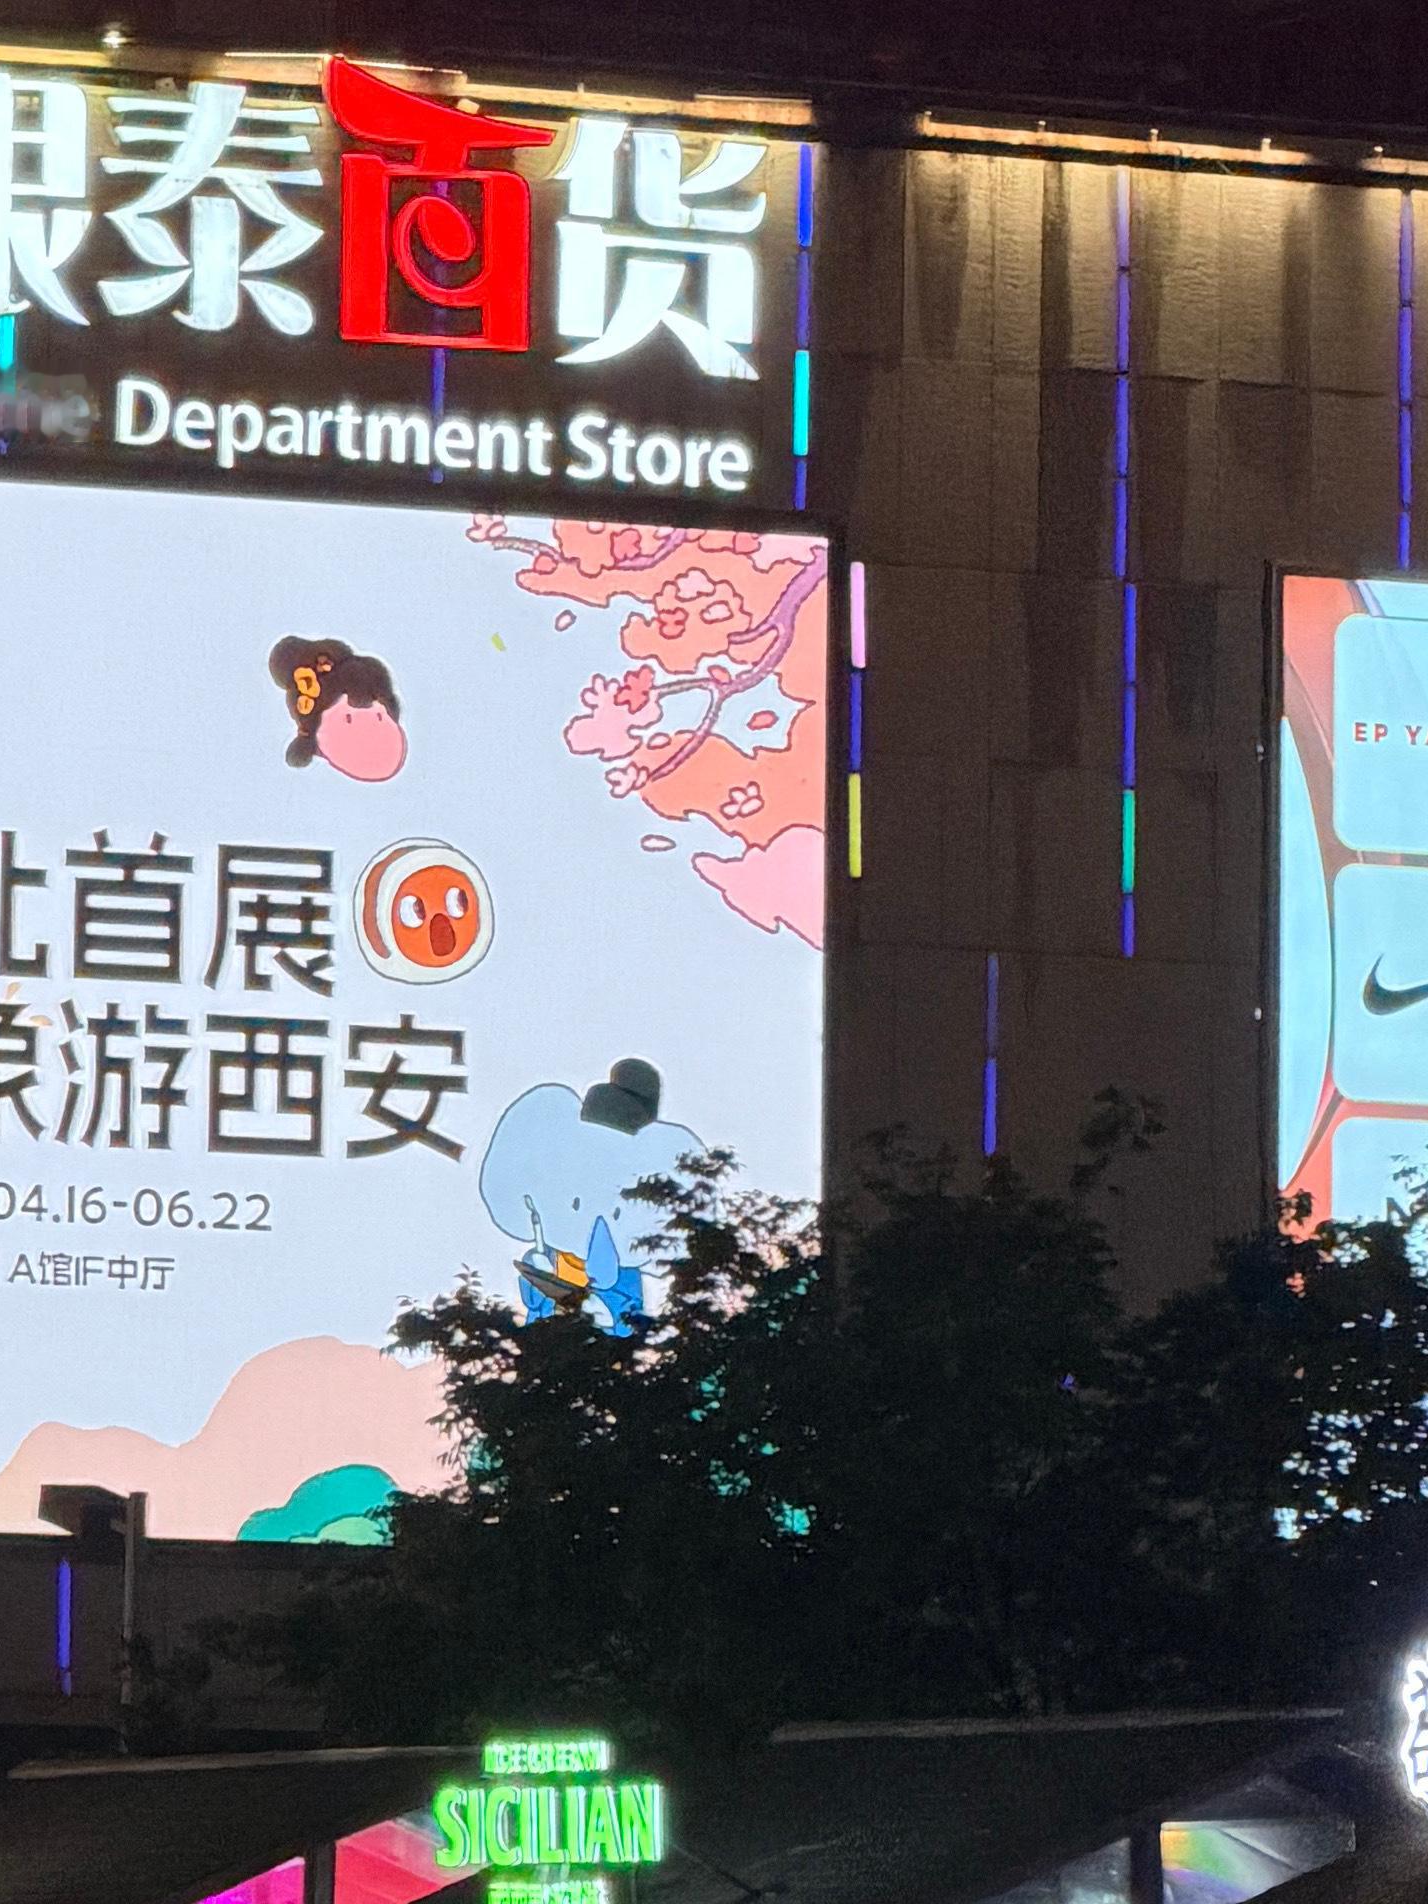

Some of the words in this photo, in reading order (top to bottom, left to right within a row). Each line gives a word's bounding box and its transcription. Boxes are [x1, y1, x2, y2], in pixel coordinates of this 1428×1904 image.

[115, 379, 554, 476] Department
[566, 413, 750, 491] Store
[1354, 722, 1388, 743] EP
[434, 1783, 665, 1867] SICILIAN
